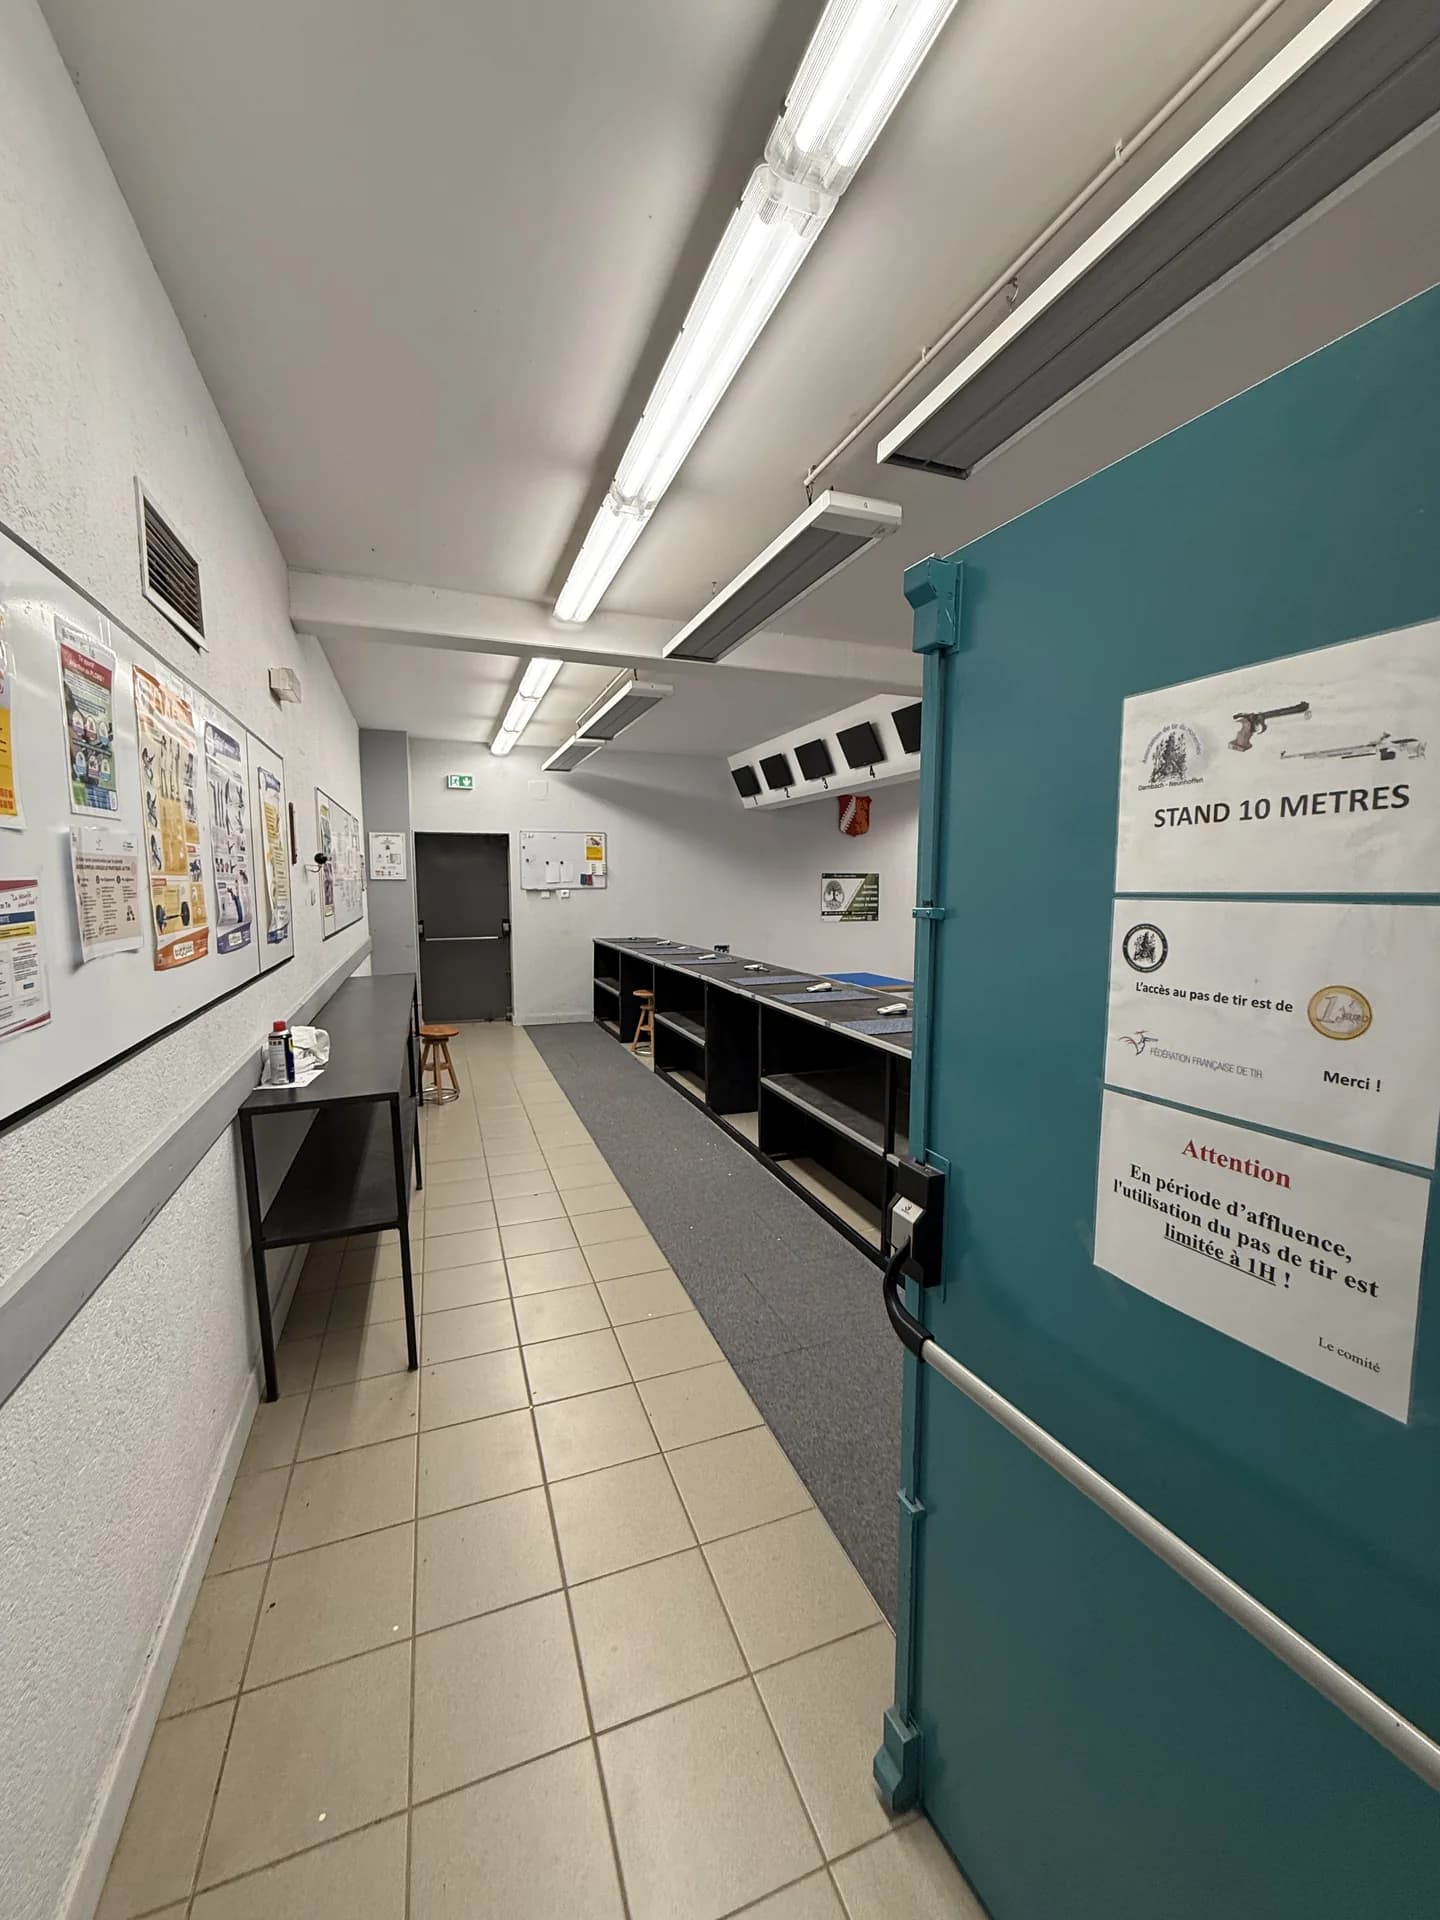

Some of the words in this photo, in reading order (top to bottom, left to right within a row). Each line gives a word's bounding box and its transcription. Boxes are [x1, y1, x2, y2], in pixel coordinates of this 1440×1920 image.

[822, 777, 829, 789] 3
[869, 765, 876, 778] 4
[753, 796, 758, 805] 1
[784, 787, 791, 798] 2
[1154, 802, 1231, 828] STAND
[1239, 798, 1271, 821] 10
[1279, 784, 1411, 818] METRES
[1135, 981, 1170, 996] L’accès
[1172, 988, 1187, 998] au
[1189, 990, 1210, 1001] pas
[1213, 991, 1229, 1004] de
[1232, 994, 1248, 1006] tir
[1251, 998, 1272, 1010] est
[1275, 1000, 1294, 1013] de
[1150, 1047, 1191, 1064] FÉDÉRATION
[1192, 1056, 1234, 1073] FRANÇAISE
[1236, 1065, 1249, 1077] DE
[1249, 1067, 1263, 1079] TIR
[1323, 1070, 1371, 1090] Merci
[1375, 1079, 1381, 1093] !
[1181, 1139, 1291, 1189] Attention
[1130, 1163, 1151, 1184] En
[1156, 1175, 1221, 1210] période
[1226, 1199, 1352, 1264] d’affluence,
[1113, 1178, 1202, 1227] l'utilisation
[1208, 1217, 1231, 1239] du
[1237, 1229, 1271, 1255] pas
[1277, 1245, 1302, 1268] de
[1309, 1256, 1338, 1282] tir
[1344, 1273, 1380, 1298] est
[1164, 1222, 1224, 1261] limitée
[1229, 1249, 1241, 1268] à
[1248, 1257, 1276, 1284] 1H
[1284, 1271, 1291, 1289] !
[1318, 1335, 1335, 1352] Le
[1337, 1348, 1381, 1374] comité
